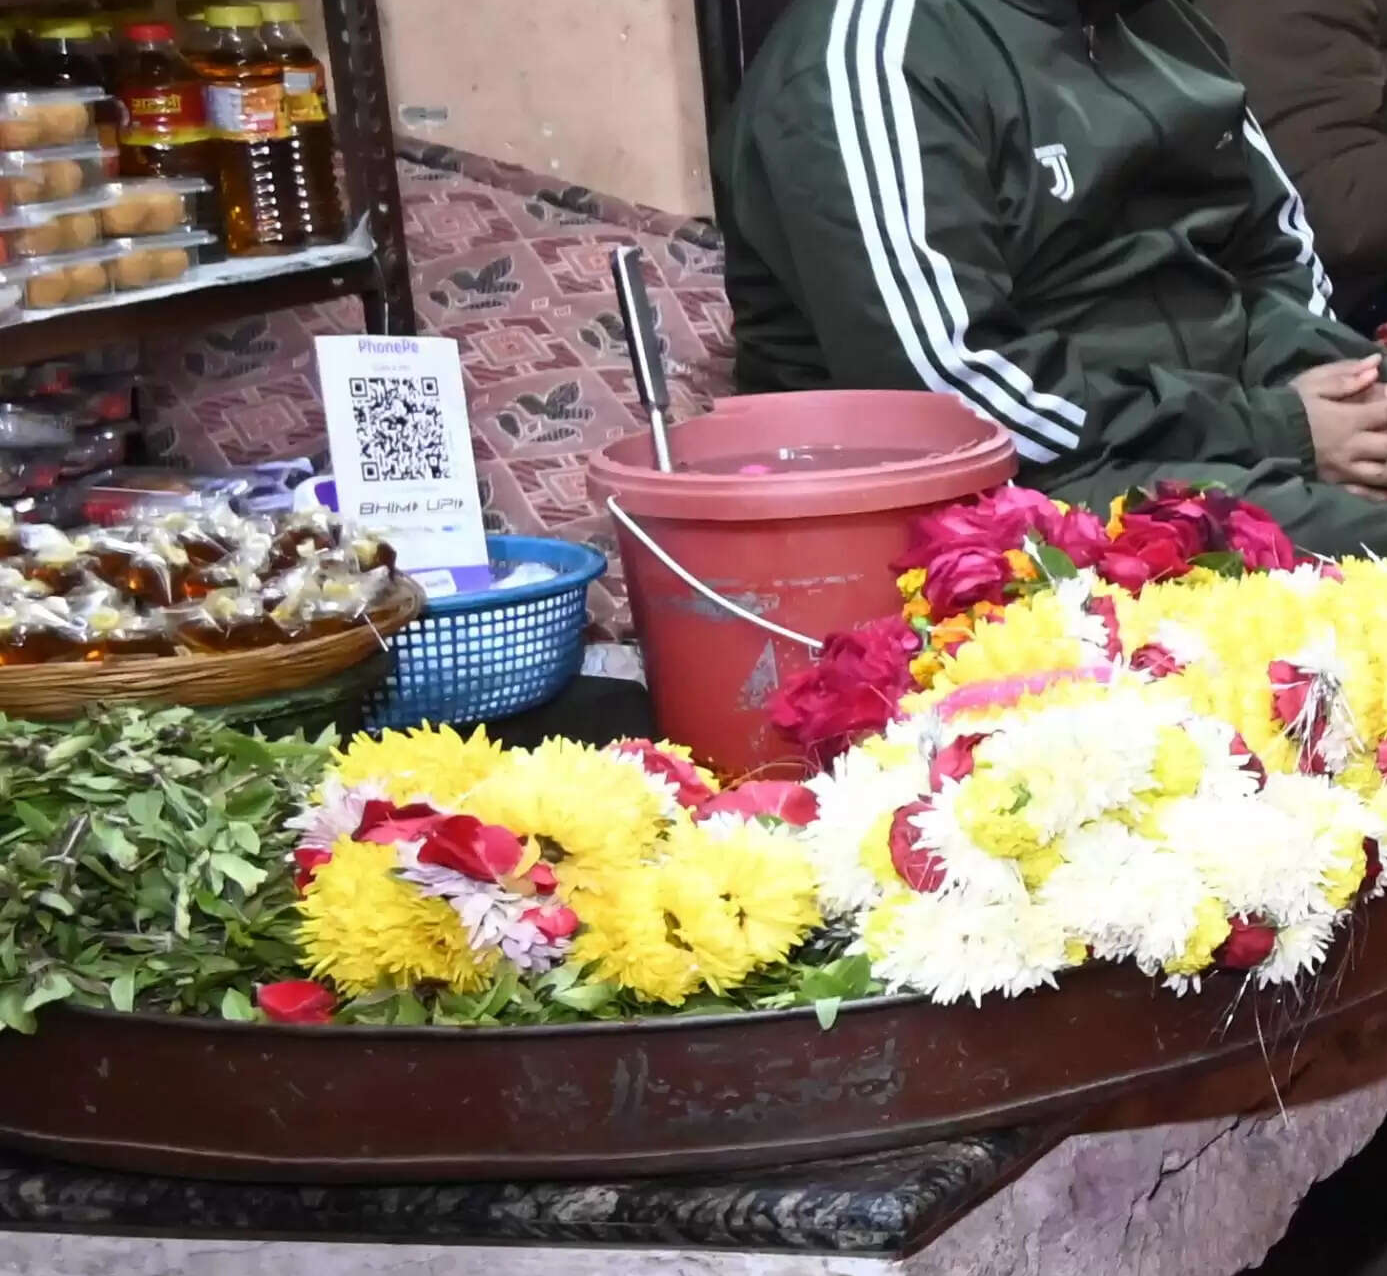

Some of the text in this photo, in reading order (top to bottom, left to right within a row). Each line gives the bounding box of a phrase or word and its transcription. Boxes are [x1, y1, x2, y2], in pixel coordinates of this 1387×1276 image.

[358, 339, 420, 355] PhonePe
[359, 497, 460, 515] BHIM UPI
